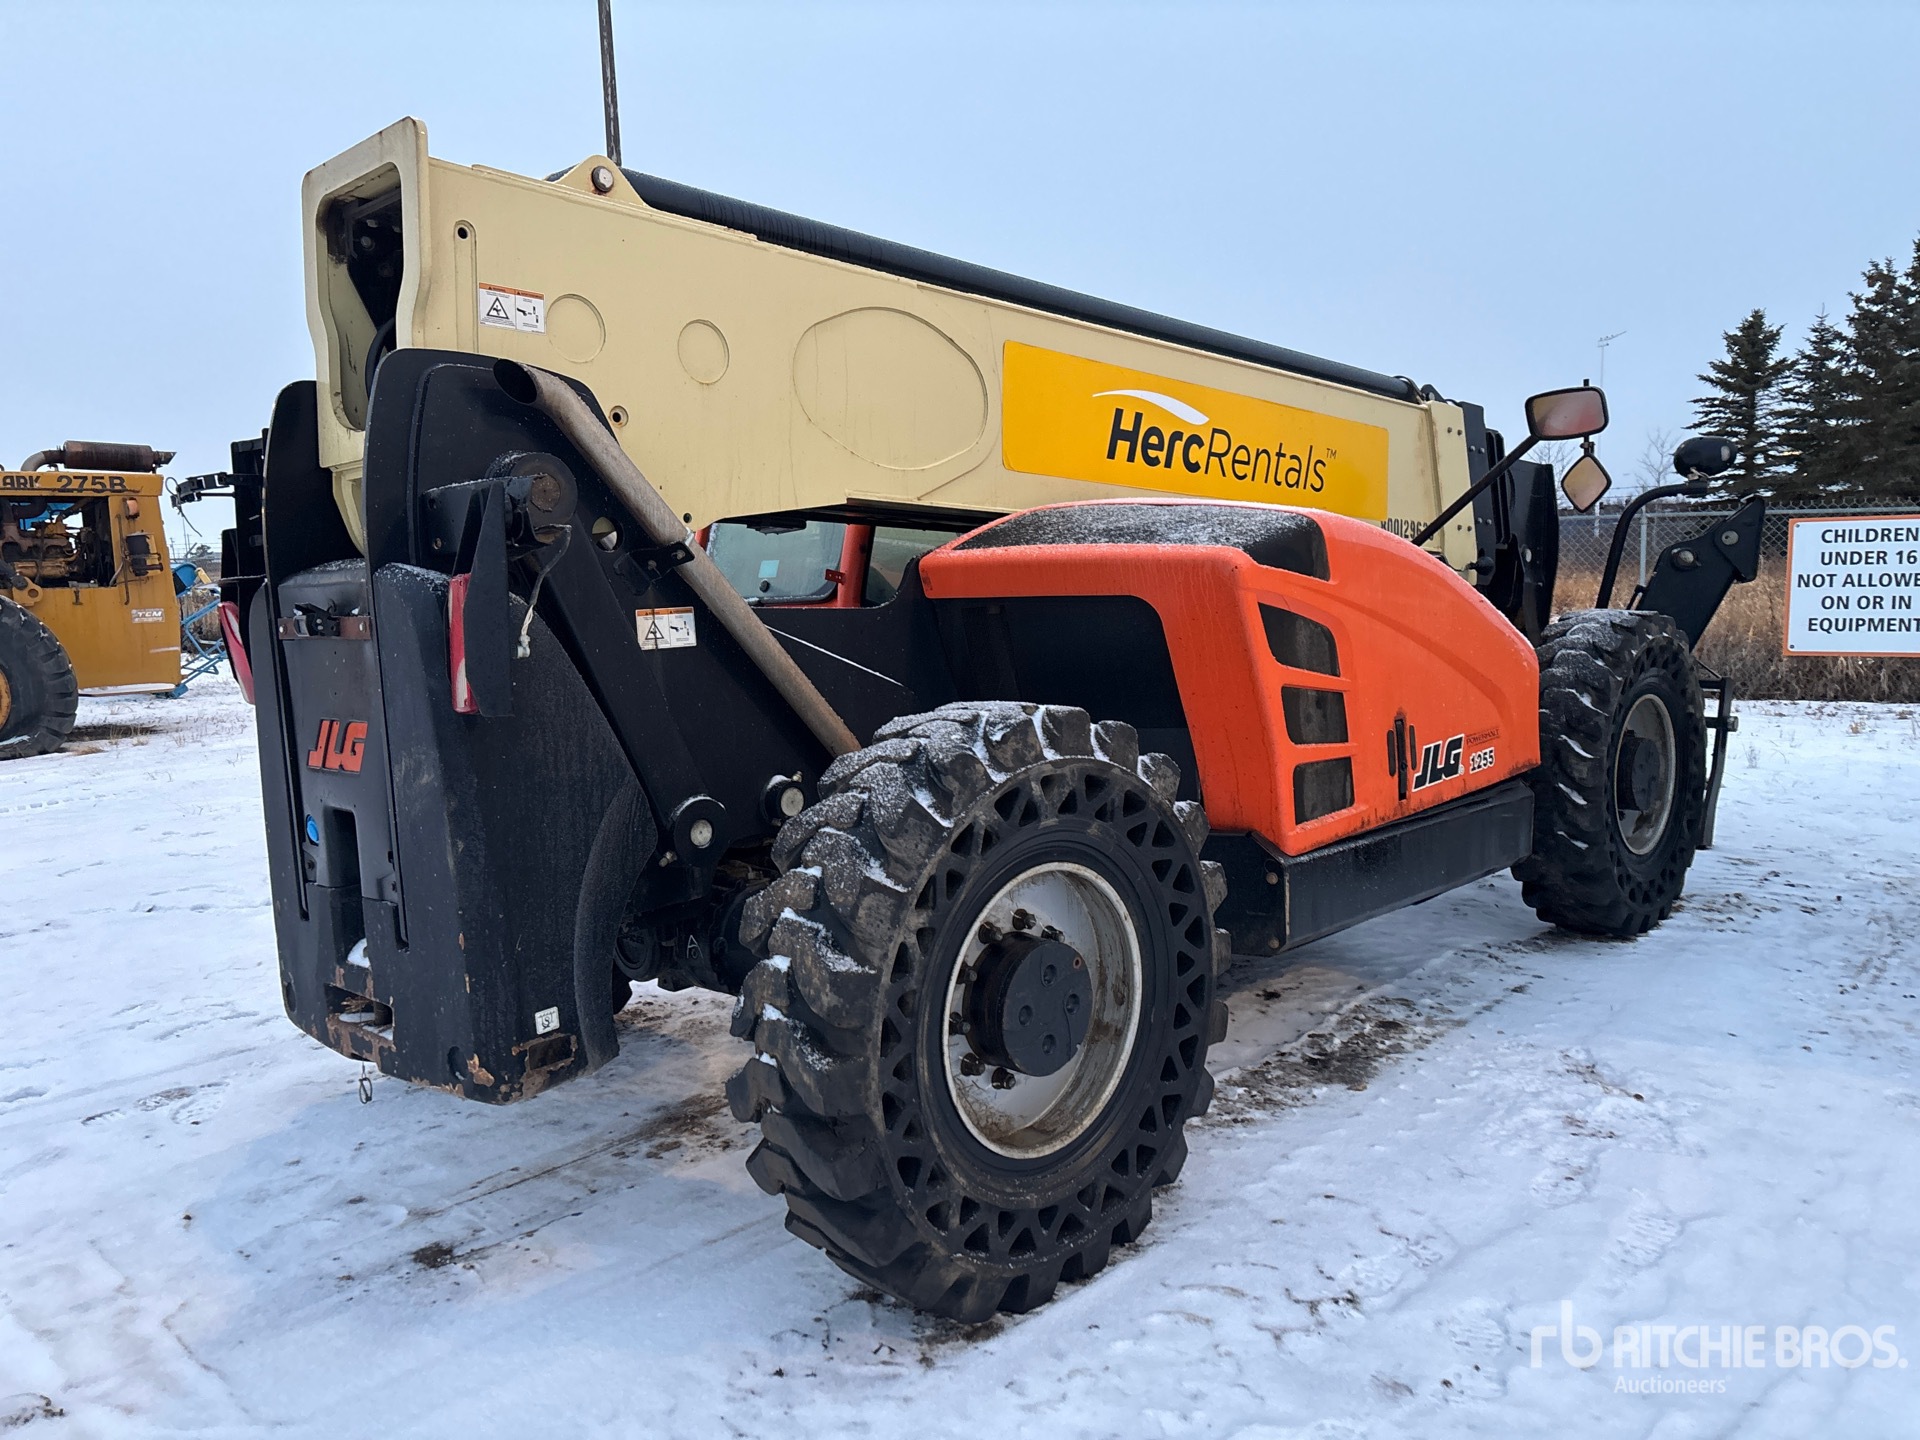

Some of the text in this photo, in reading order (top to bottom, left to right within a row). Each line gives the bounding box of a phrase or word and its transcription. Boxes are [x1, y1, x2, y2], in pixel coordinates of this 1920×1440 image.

[56, 475, 128, 494] 275B
[1821, 527, 1919, 544] CHILDREN
[1820, 550, 1918, 566] UNDER 16
[1797, 573, 1837, 588] NOT
[1821, 595, 1912, 610] ON OR IN
[1808, 617, 1920, 634] EQUIPMENT
[307, 719, 368, 773] JLG
[1470, 748, 1494, 773] 1255
